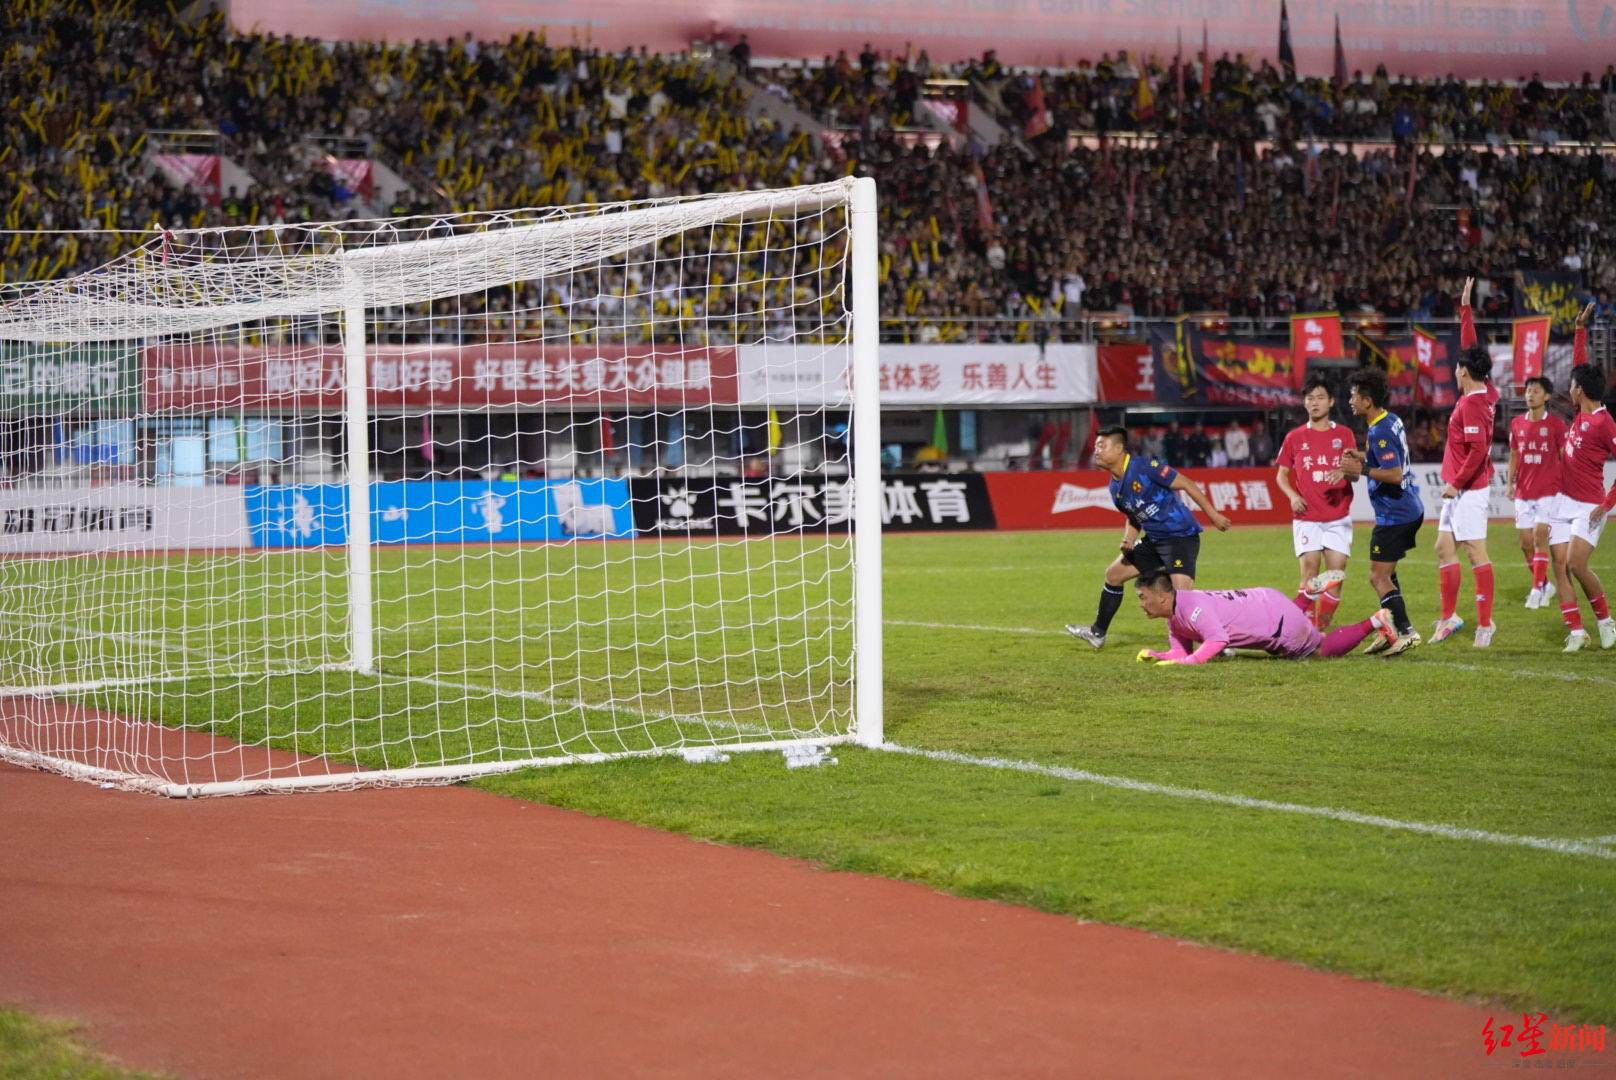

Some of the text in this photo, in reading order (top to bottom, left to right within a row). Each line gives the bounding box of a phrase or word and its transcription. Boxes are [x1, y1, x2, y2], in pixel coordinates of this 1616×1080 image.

[1444, 3, 1547, 34] League
[473, 357, 712, 392] 好医生关爱大众健康
[962, 362, 1057, 391] 乐善人生
[718, 480, 970, 528] 卡尔美体育
